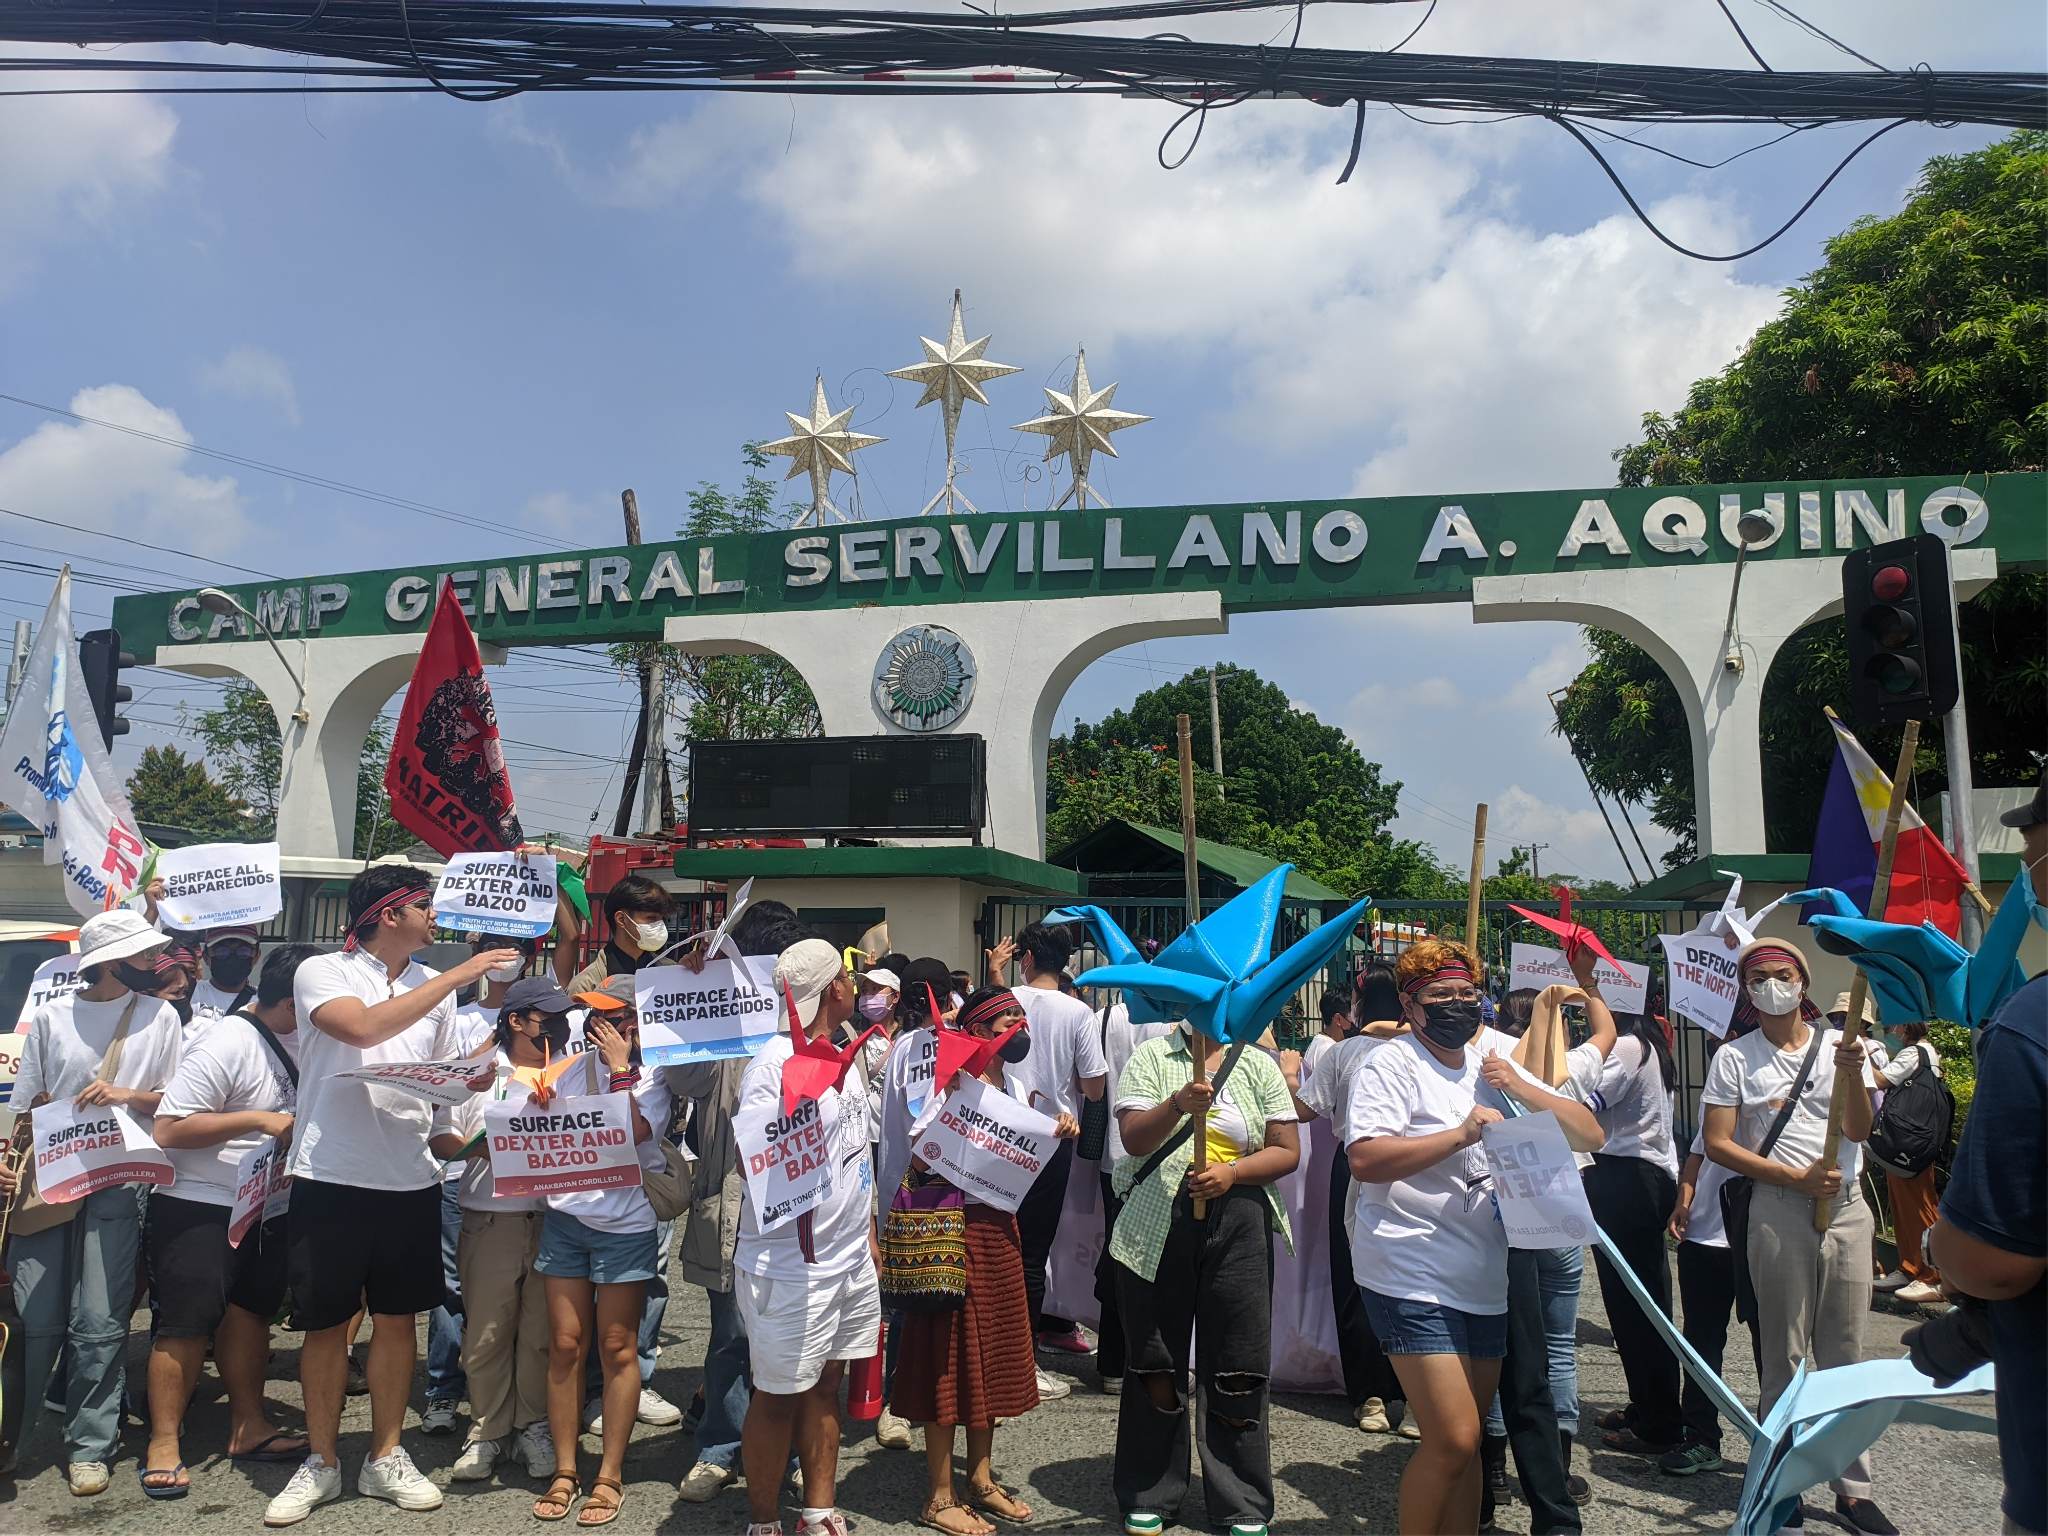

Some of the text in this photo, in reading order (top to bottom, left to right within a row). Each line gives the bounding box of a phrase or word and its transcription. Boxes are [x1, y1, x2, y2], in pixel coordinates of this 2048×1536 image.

[167, 486, 1990, 642] CAMP GENERAL SERVILLANO A. AQUINO
[170, 863, 264, 886] SURFACE ALL
[463, 862, 540, 882] SURFACE
[164, 873, 275, 898] DESAPARECIDOS
[443, 876, 553, 899] DEXTER AND
[464, 892, 527, 913] BAZOO
[1686, 947, 1738, 979] DEFEND
[1673, 961, 1739, 1003] THE NORTH
[653, 985, 761, 1009] SURFACE ALL
[642, 998, 774, 1026] DESAPARECIDOS
[48, 1118, 120, 1147] SURFACE
[508, 1111, 606, 1133] SURFACE
[959, 1104, 1038, 1156] SURFACE ALL
[493, 1128, 627, 1152] DEXTER AND
[750, 1119, 826, 1176] DEXTER
[939, 1111, 1041, 1173] DESAPARECIDOS
[527, 1150, 599, 1170] BAZOO
[784, 1143, 829, 1182] BAZ
[941, 1157, 976, 1183] CORDILLERA
[70, 1170, 157, 1196] ANAKBAYAN CORDILLERA
[533, 1175, 624, 1192] ANAKBAYAN CORDILLERA
